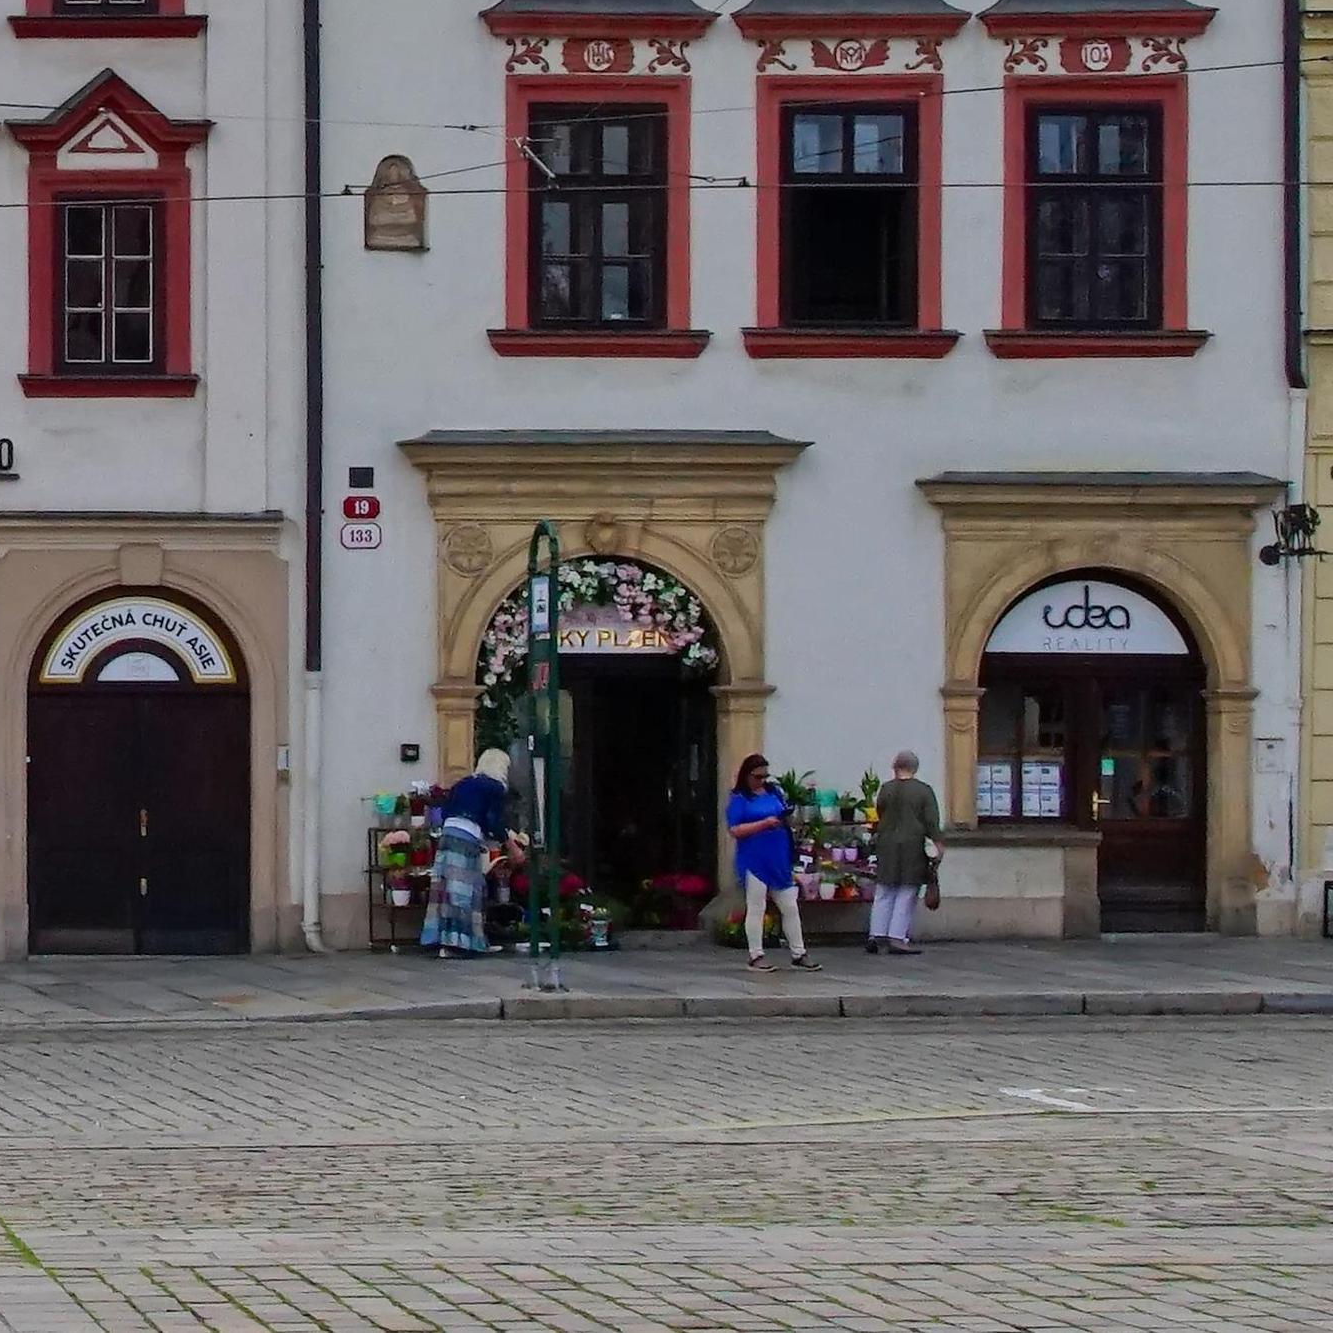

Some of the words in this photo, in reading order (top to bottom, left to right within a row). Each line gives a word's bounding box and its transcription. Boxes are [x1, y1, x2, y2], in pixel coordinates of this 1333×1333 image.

[354, 500, 370, 515] 19
[350, 529, 373, 543] 133
[1042, 585, 1131, 629] idea
[61, 609, 136, 670] SKUTEČNÁ
[142, 612, 188, 638] CHUŤ
[186, 637, 216, 670] ASIE
[1042, 637, 1130, 651] REALITY
